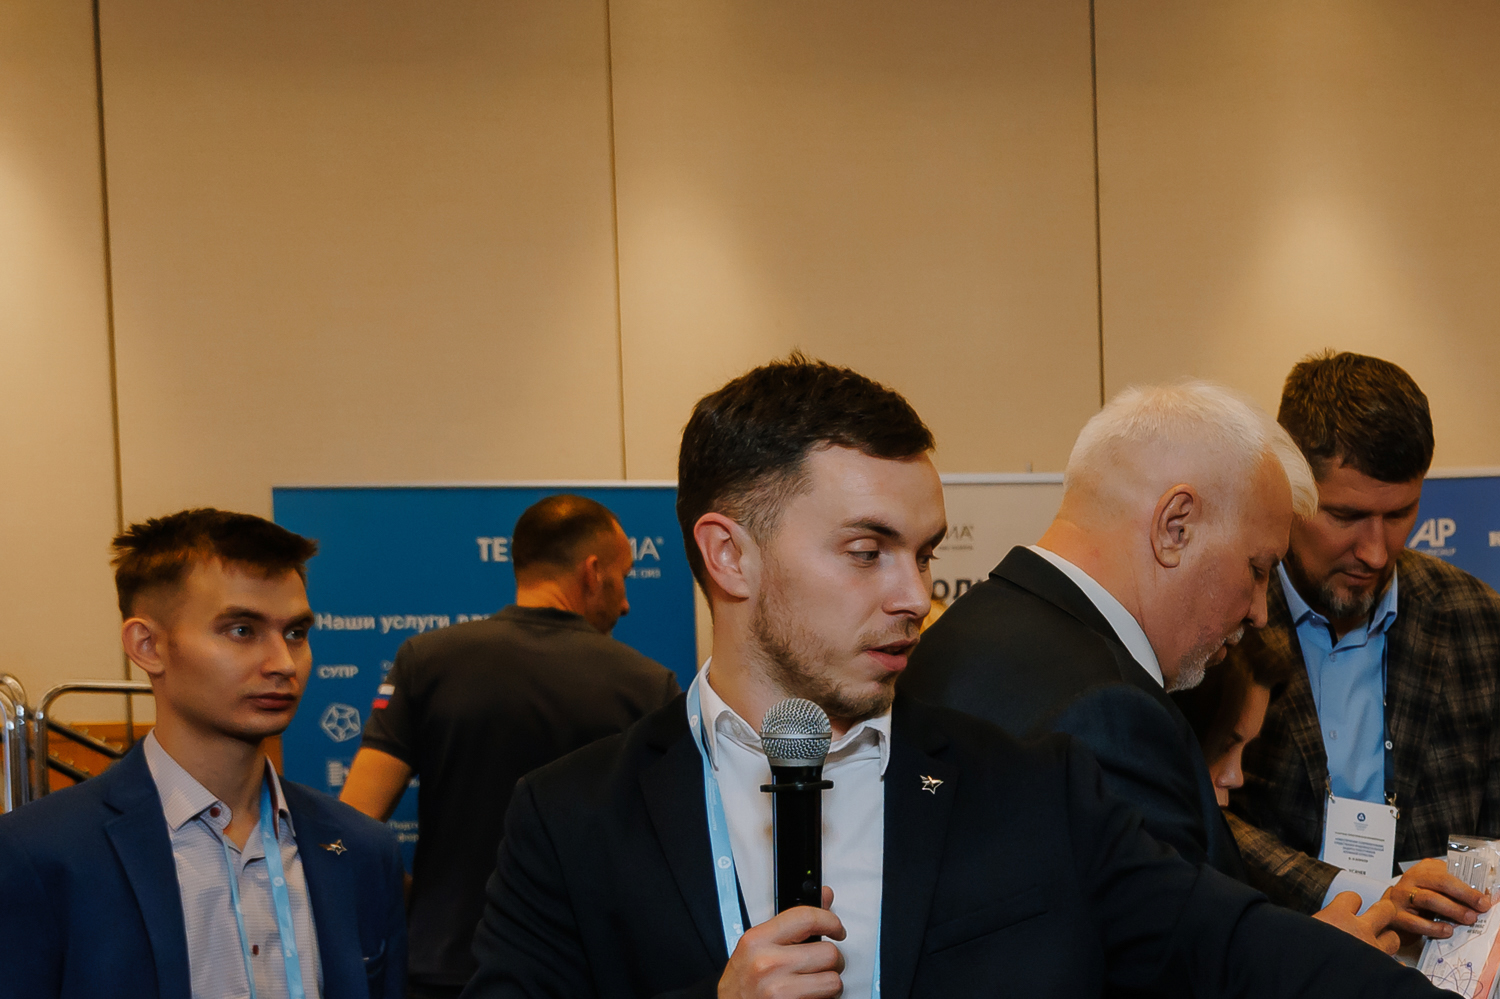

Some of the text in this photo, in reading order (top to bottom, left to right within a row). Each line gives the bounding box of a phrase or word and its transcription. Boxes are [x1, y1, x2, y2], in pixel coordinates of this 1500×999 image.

[315, 613, 375, 630] Наши
[380, 614, 450, 634] услуги
[318, 664, 359, 679] СУПР
